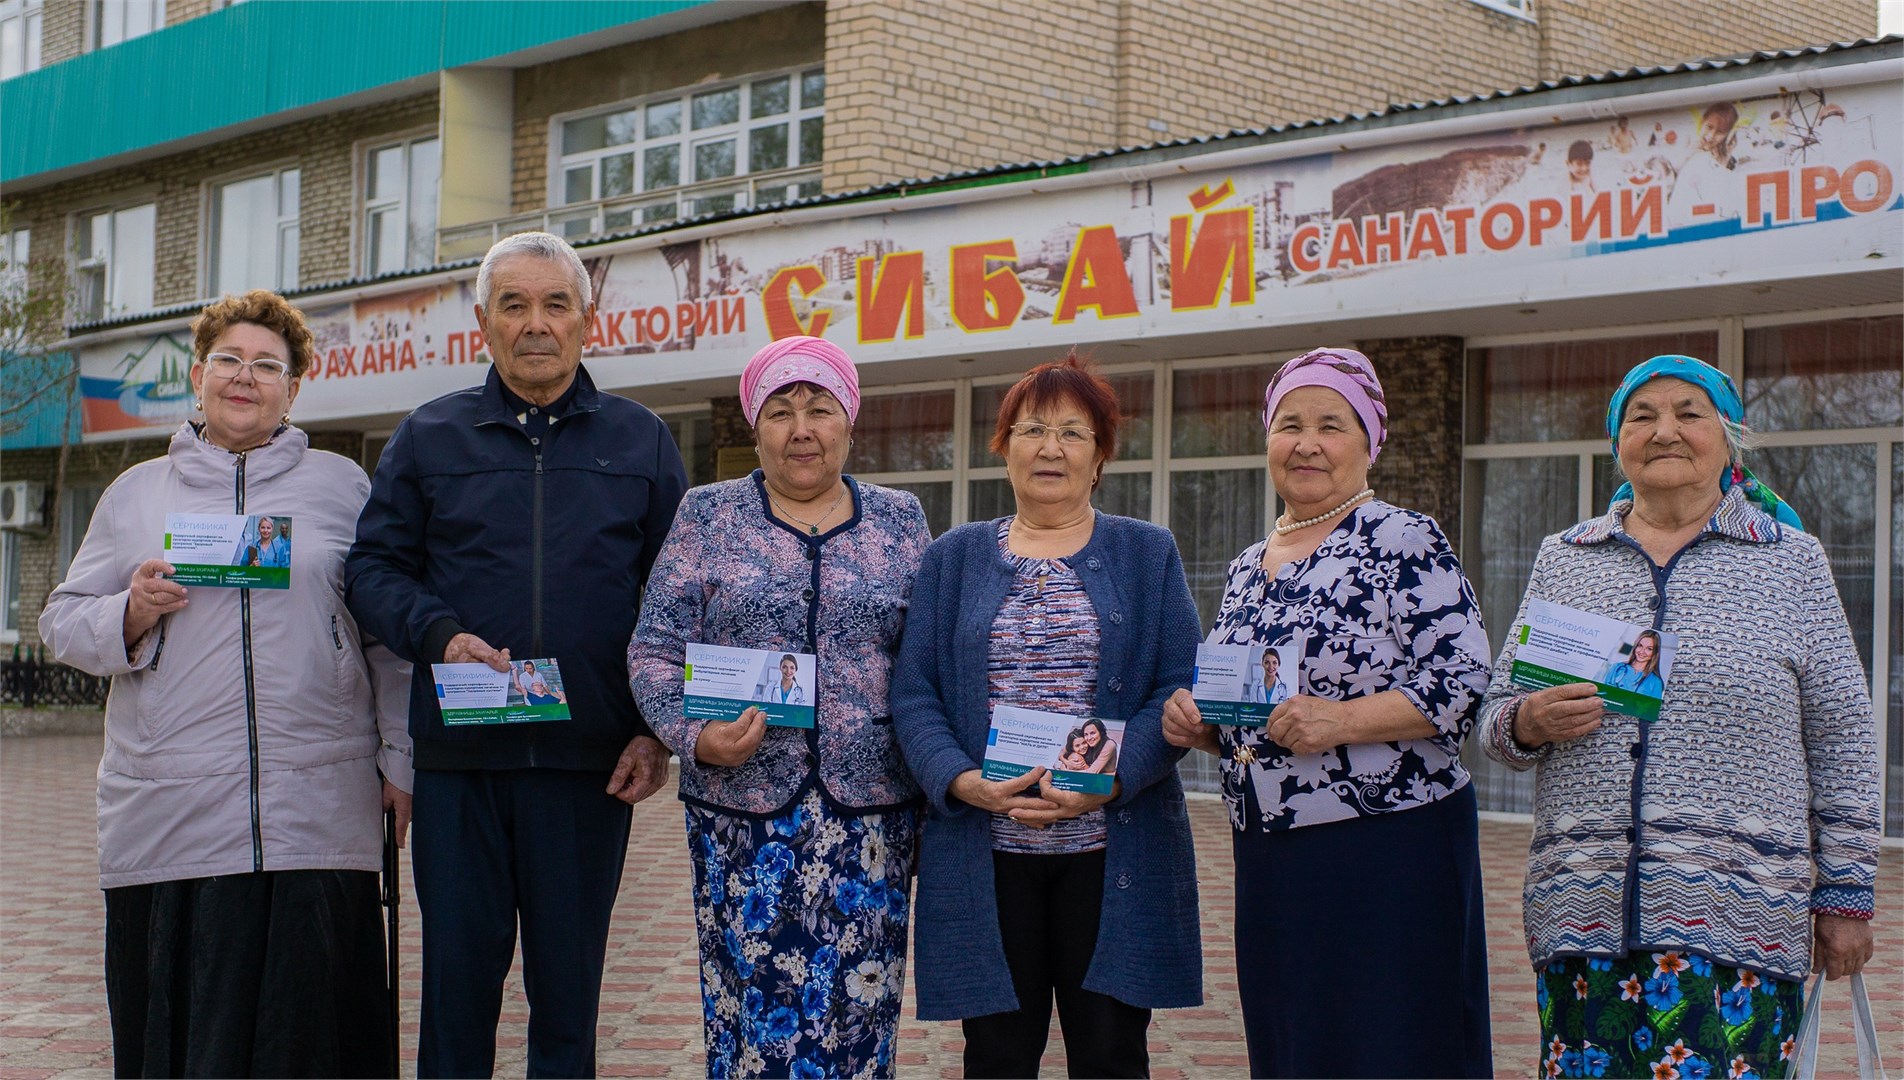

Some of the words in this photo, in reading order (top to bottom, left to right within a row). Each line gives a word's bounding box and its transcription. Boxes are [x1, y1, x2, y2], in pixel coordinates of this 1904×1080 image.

[1291, 173, 1664, 272] САНАТОРИЙ
[1746, 159, 1894, 225] ПРО
[762, 178, 1256, 344] СИБАЙ
[174, 522, 228, 530] СЕРТИФИКАТ
[1534, 614, 1600, 638] СЕРТИФИКАТ
[694, 653, 751, 665] СЕРТИФИКАТ
[1200, 654, 1237, 663] СЕРТИФИКАТ
[441, 670, 497, 682] СЕРТИФИКАТ
[1001, 718, 1059, 733] СЕРТИФИКАТ
